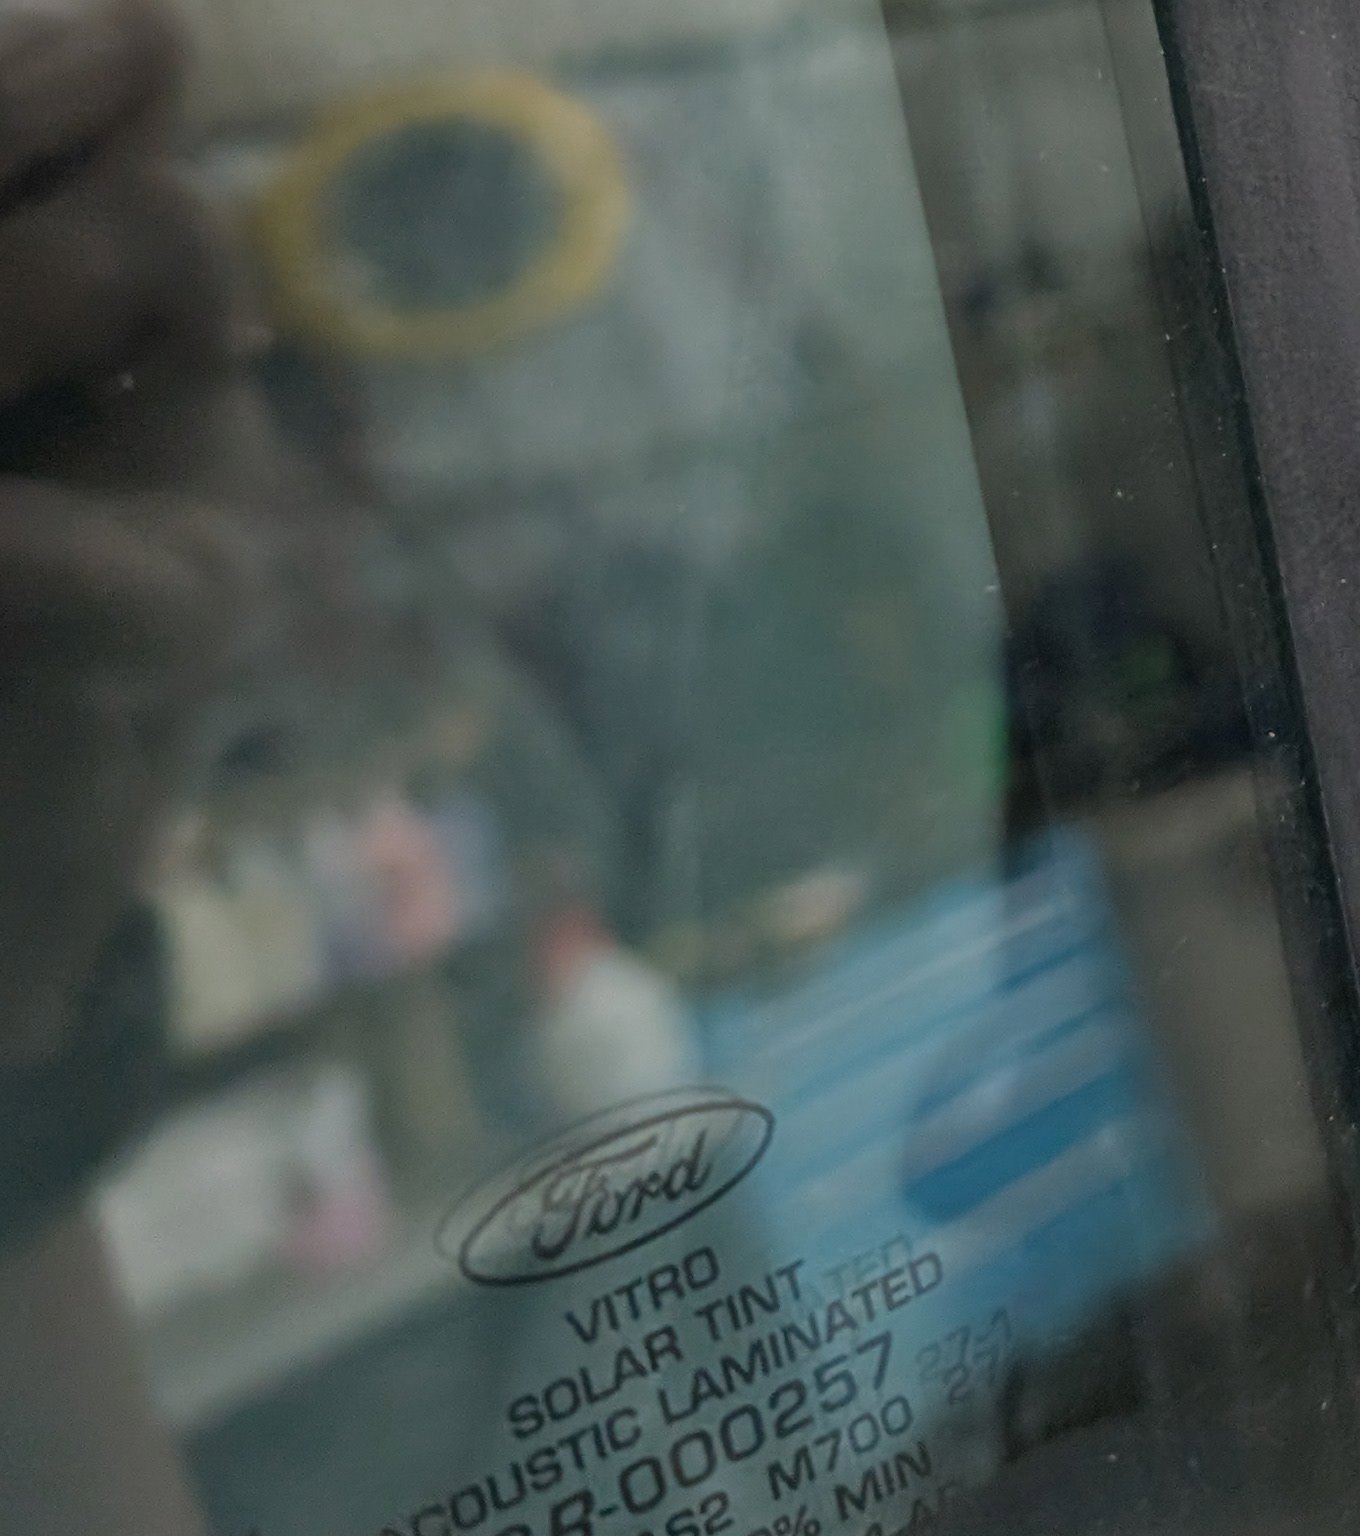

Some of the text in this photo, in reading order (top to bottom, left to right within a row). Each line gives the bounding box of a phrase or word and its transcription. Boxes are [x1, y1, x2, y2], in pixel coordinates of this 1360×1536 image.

[531, 1127, 715, 1260] Ford
[507, 1259, 805, 1440] SOLAR TINT
[564, 1246, 720, 1344] VITRO
[378, 1251, 944, 1536] COUSTIC LAMINATED
[494, 1331, 893, 1536] R-000257
[767, 1395, 914, 1501] M700
[833, 1440, 934, 1521] MIN
